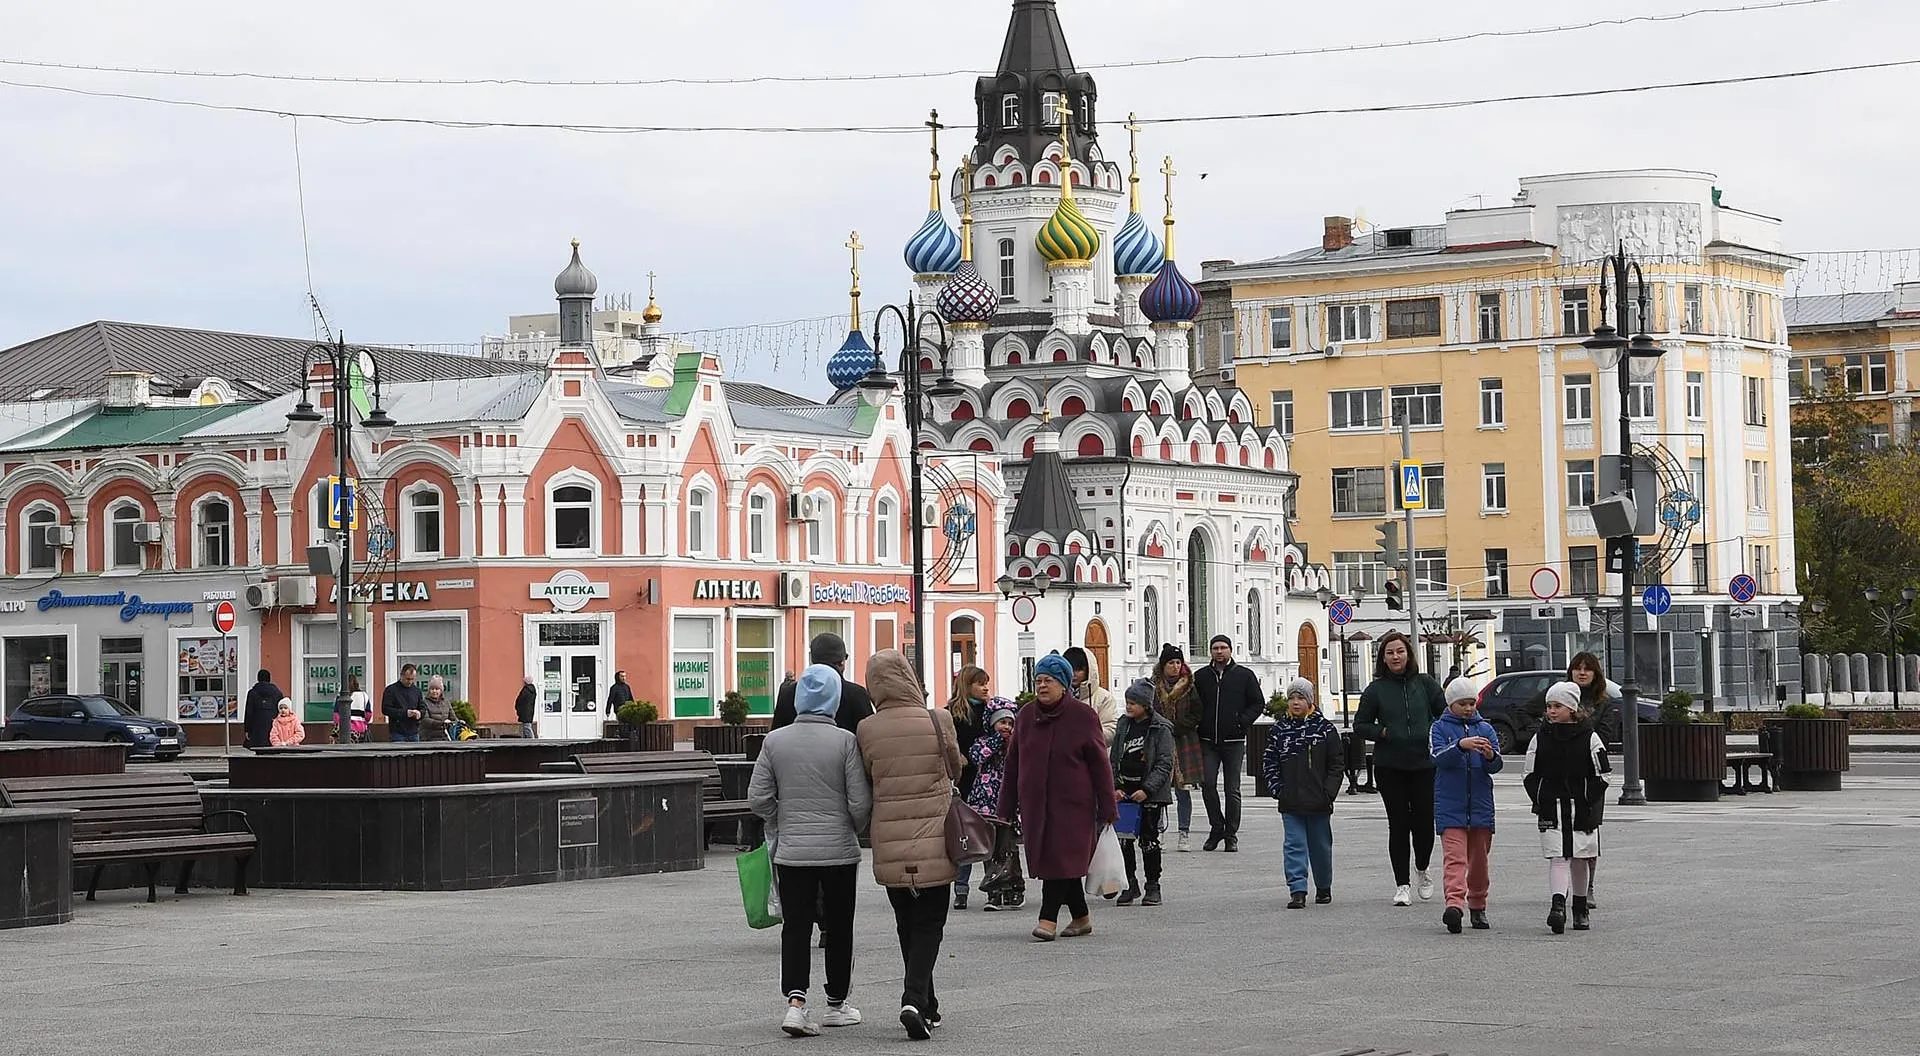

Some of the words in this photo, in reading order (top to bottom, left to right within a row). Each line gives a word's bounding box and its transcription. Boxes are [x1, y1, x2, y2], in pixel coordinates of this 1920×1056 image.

[544, 586, 595, 596] АПТЕКА
[695, 580, 763, 599] АПТЕКА
[674, 661, 709, 673] НИЗКИЕ
[678, 678, 705, 690] ЦЕНЫ
